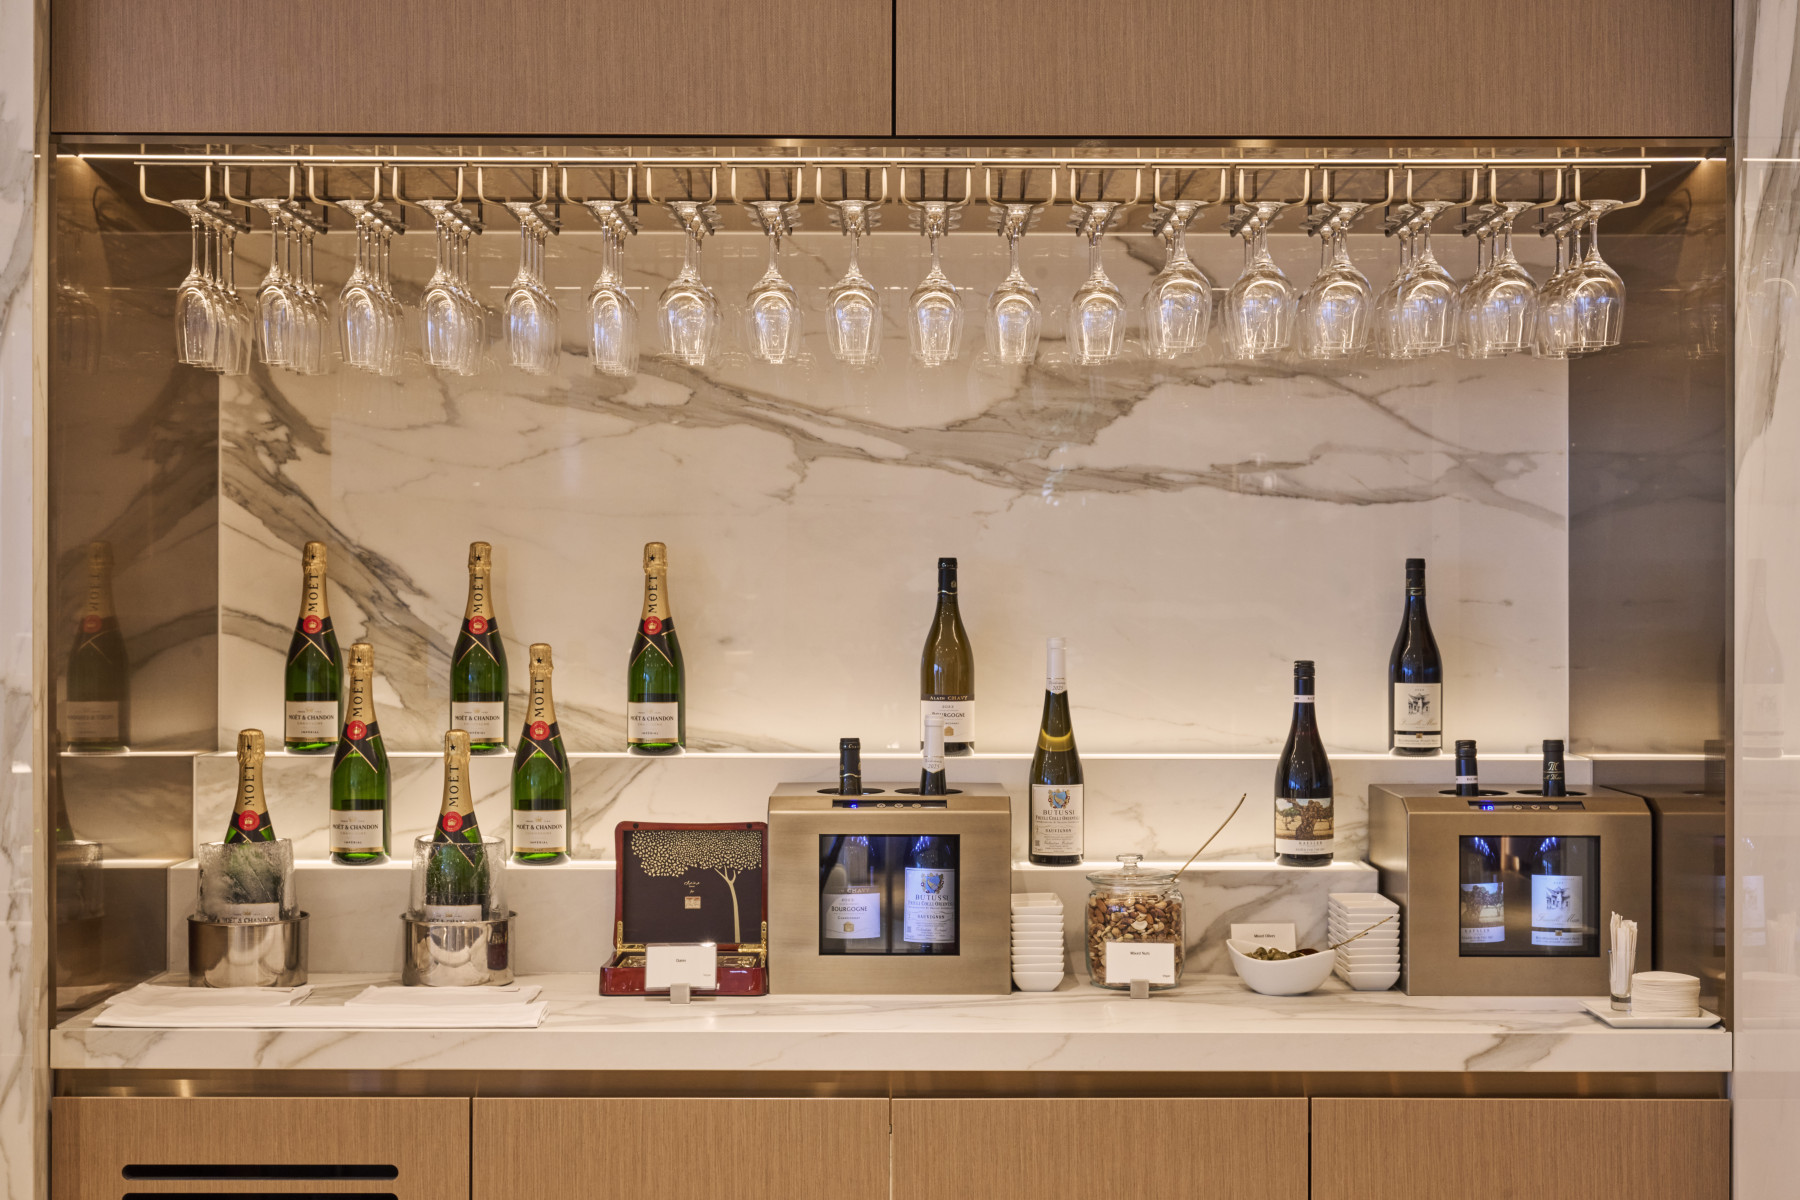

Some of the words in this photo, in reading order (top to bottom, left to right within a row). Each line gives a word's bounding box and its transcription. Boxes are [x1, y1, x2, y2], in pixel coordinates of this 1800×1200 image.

[352, 676, 363, 718] MOËT
[533, 677, 544, 718] MOËT
[448, 765, 459, 807] MOËT
